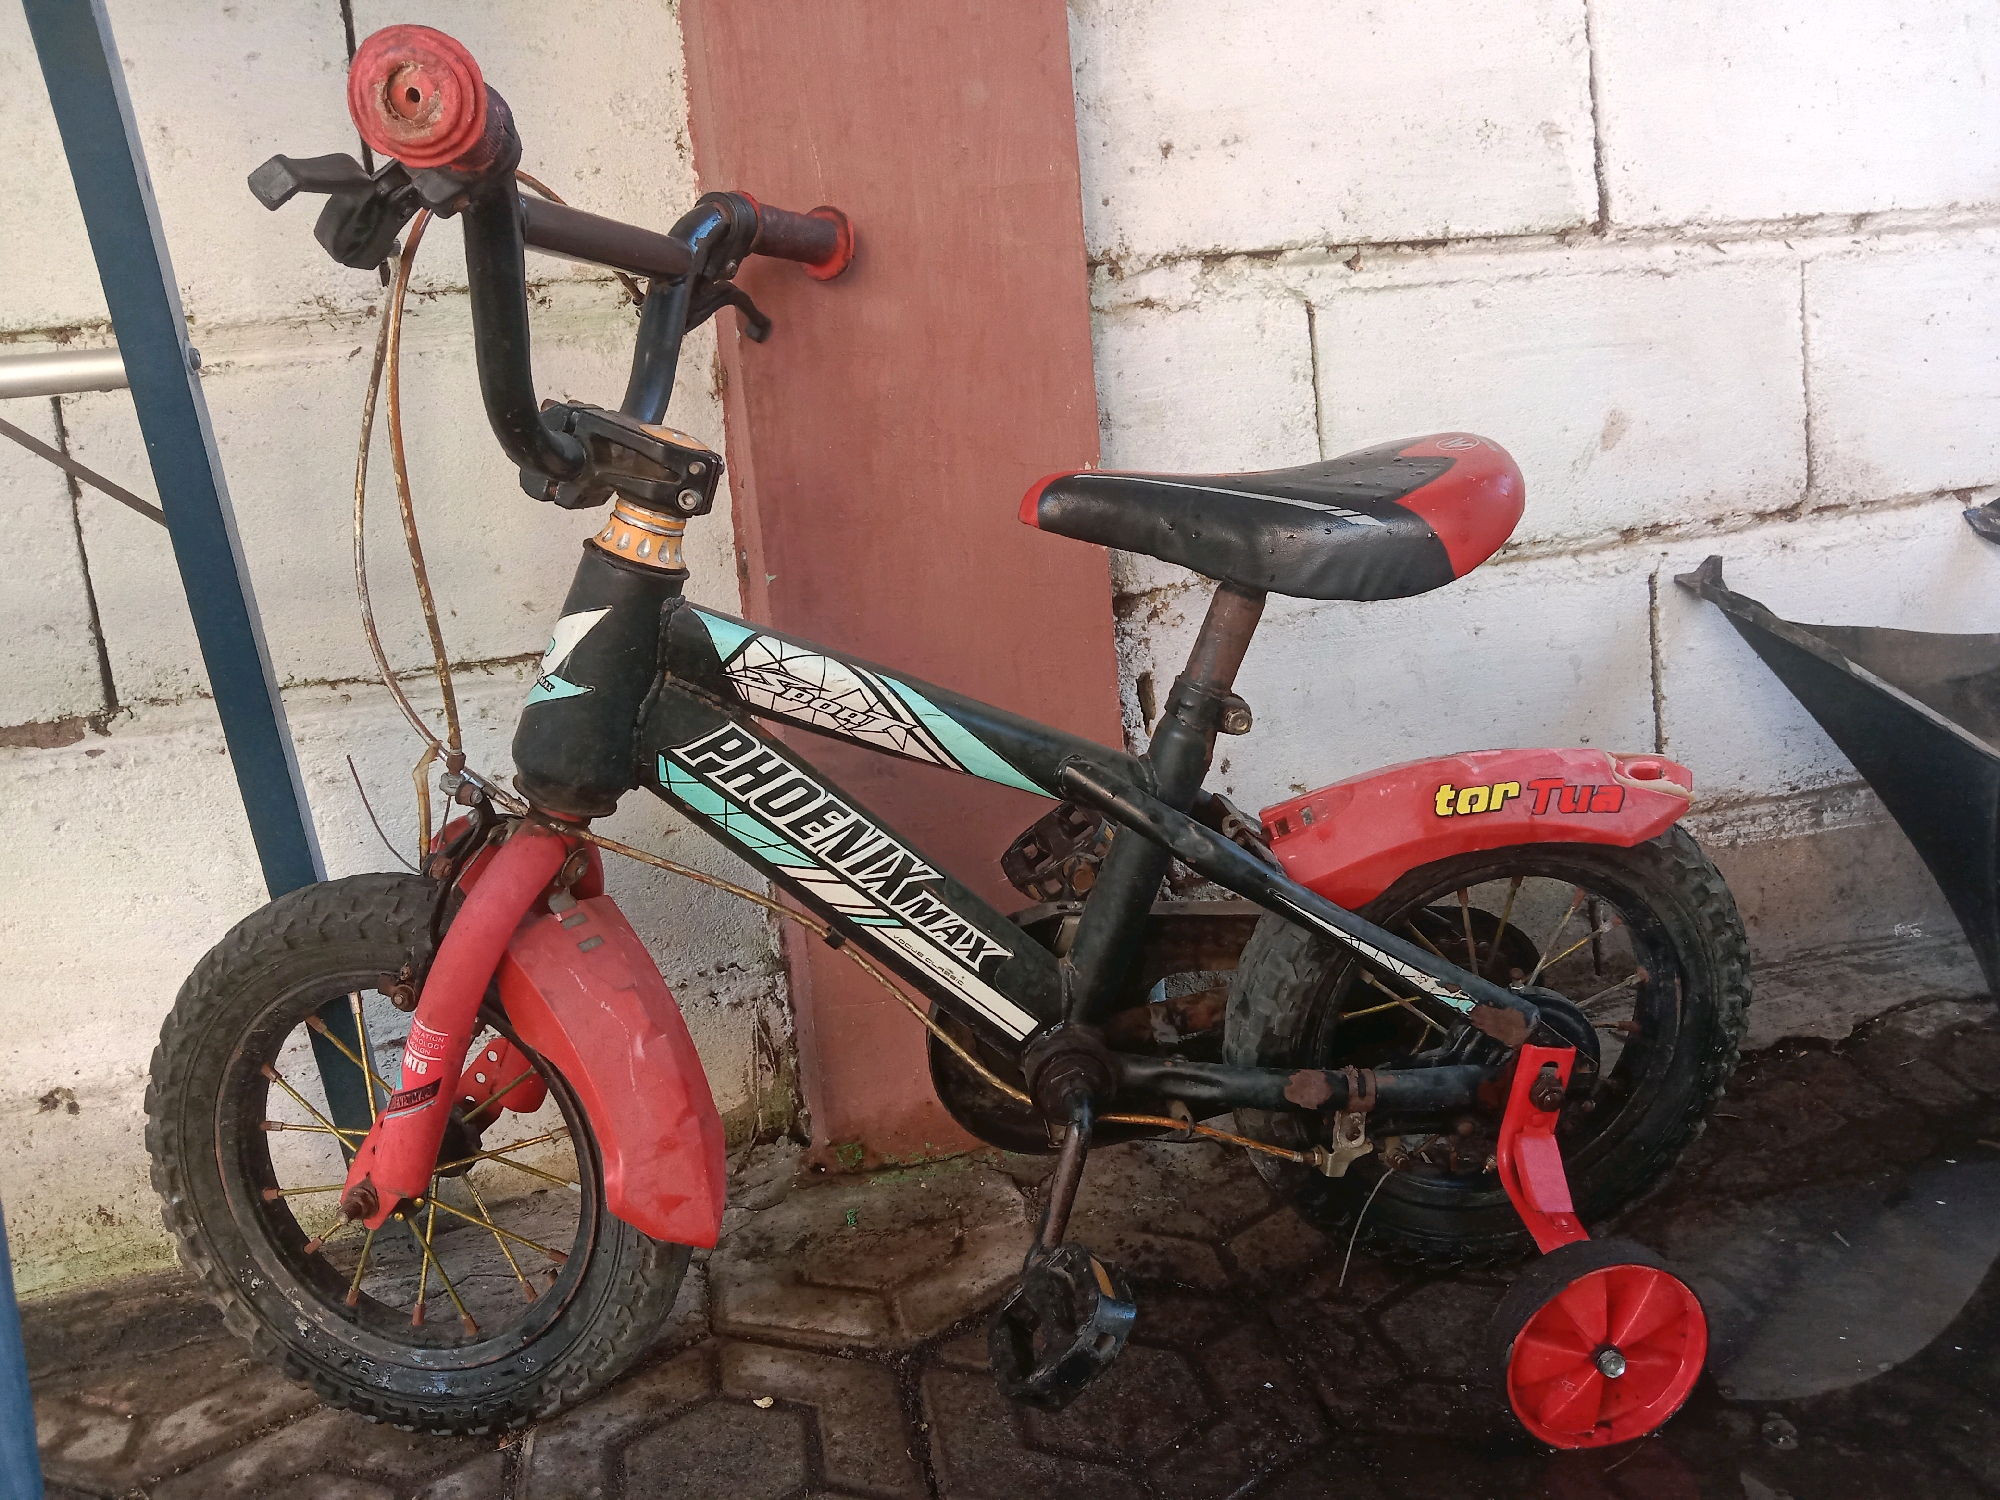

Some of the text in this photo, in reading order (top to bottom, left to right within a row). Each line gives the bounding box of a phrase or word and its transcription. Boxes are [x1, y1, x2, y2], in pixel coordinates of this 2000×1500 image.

[722, 667, 920, 733] SPORT
[675, 722, 1013, 971] PHOENIX MAX
[403, 1050, 429, 1075] MTB
